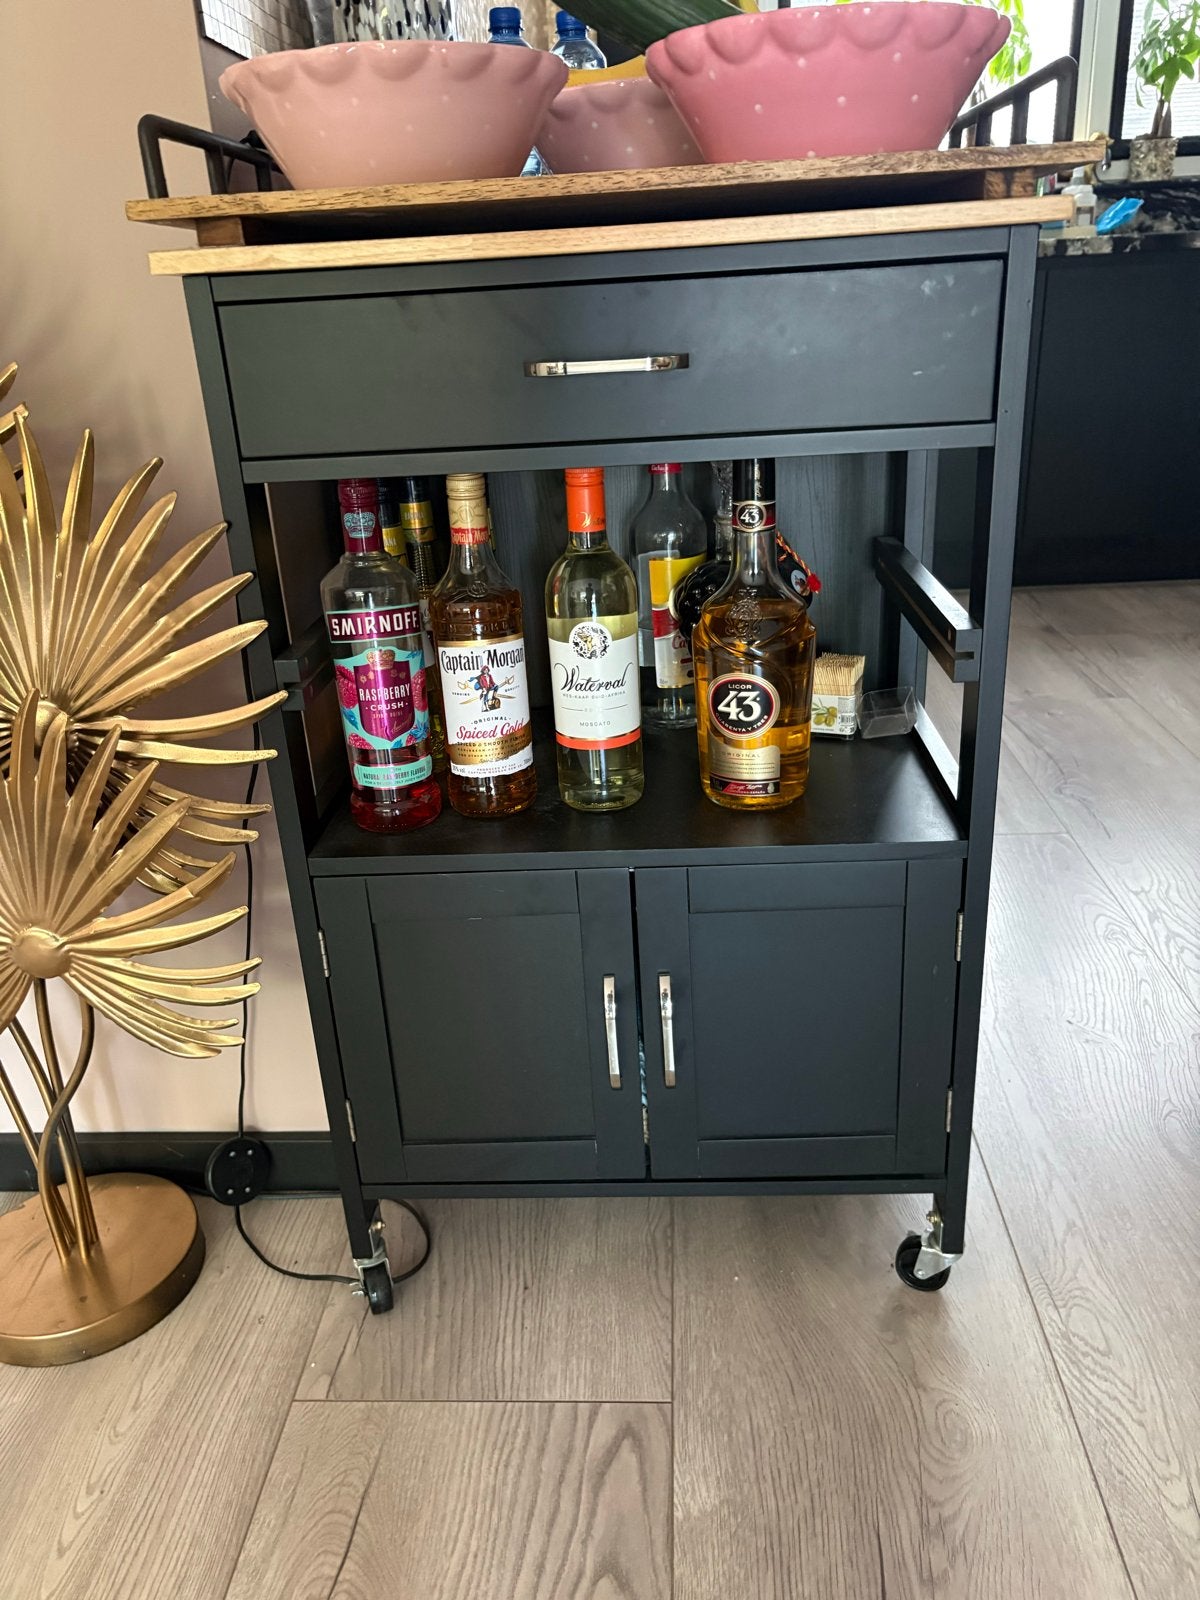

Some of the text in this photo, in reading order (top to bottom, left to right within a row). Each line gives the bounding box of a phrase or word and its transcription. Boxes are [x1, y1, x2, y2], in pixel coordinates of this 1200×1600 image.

[740, 508, 760, 524] 43
[331, 610, 418, 636] SMIRNOFF
[441, 647, 524, 674] Captain Morgan
[554, 662, 633, 692] Waterval
[359, 683, 411, 701] RASPBERRY
[370, 701, 404, 711] CRUSH
[717, 690, 761, 722] 43
[456, 718, 524, 740] Spiced Gold
[474, 716, 508, 725] ORIGINAL
